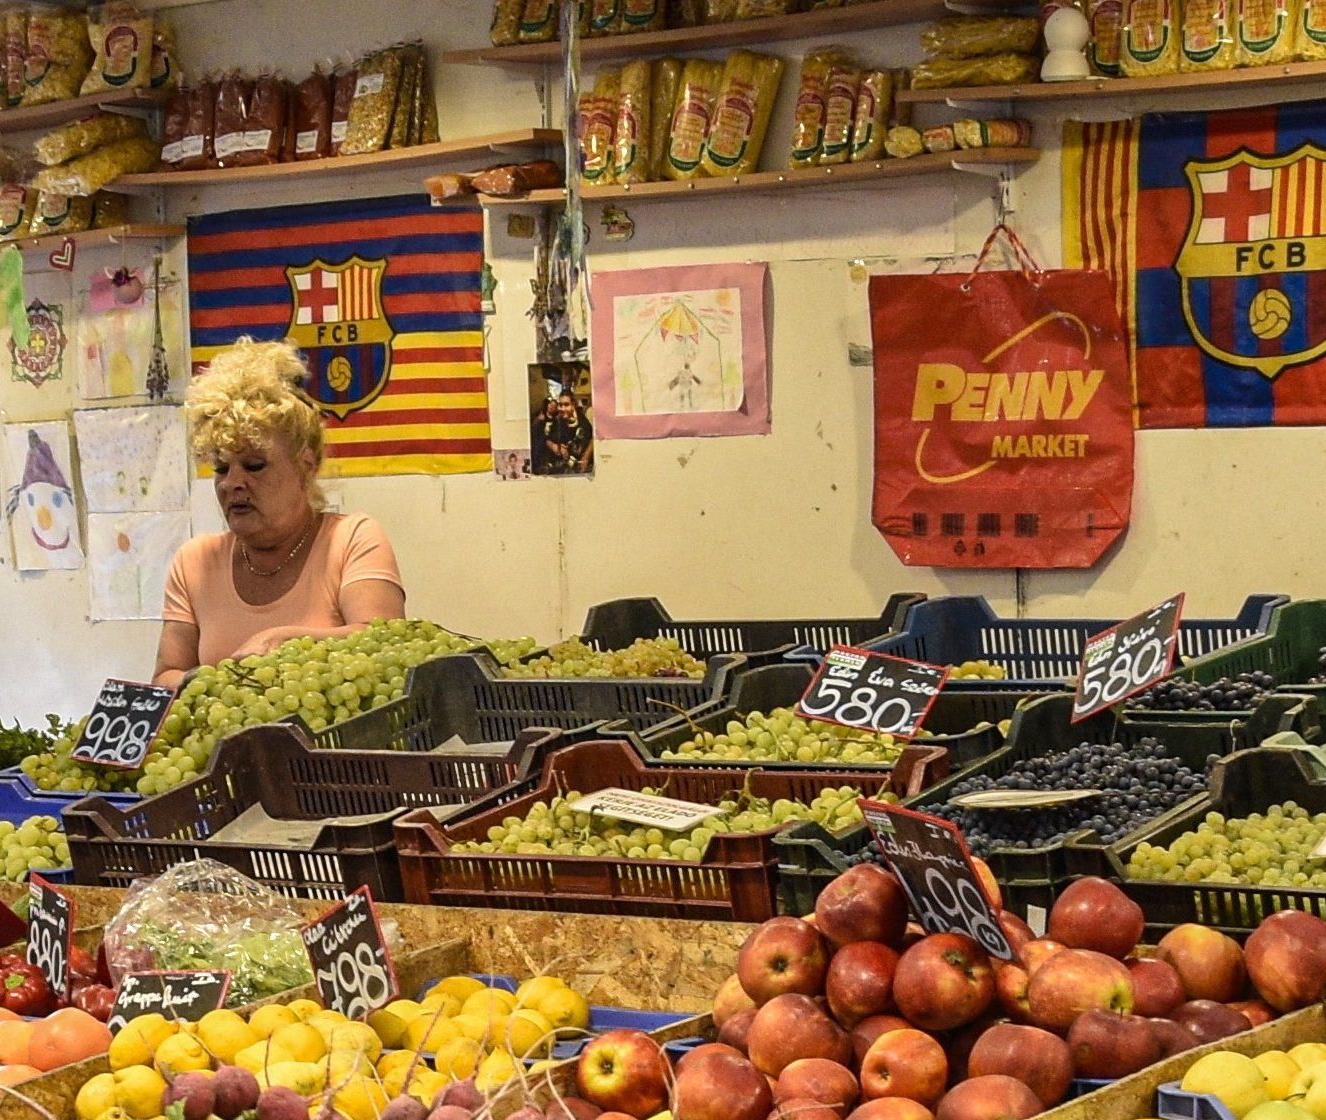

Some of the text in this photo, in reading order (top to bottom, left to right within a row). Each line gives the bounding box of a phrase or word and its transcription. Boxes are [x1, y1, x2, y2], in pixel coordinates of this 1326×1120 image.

[1236, 242, 1307, 272] FCB
[317, 324, 359, 344] FCB
[911, 362, 1105, 421] PENNY
[991, 433, 1090, 458] MARKET
